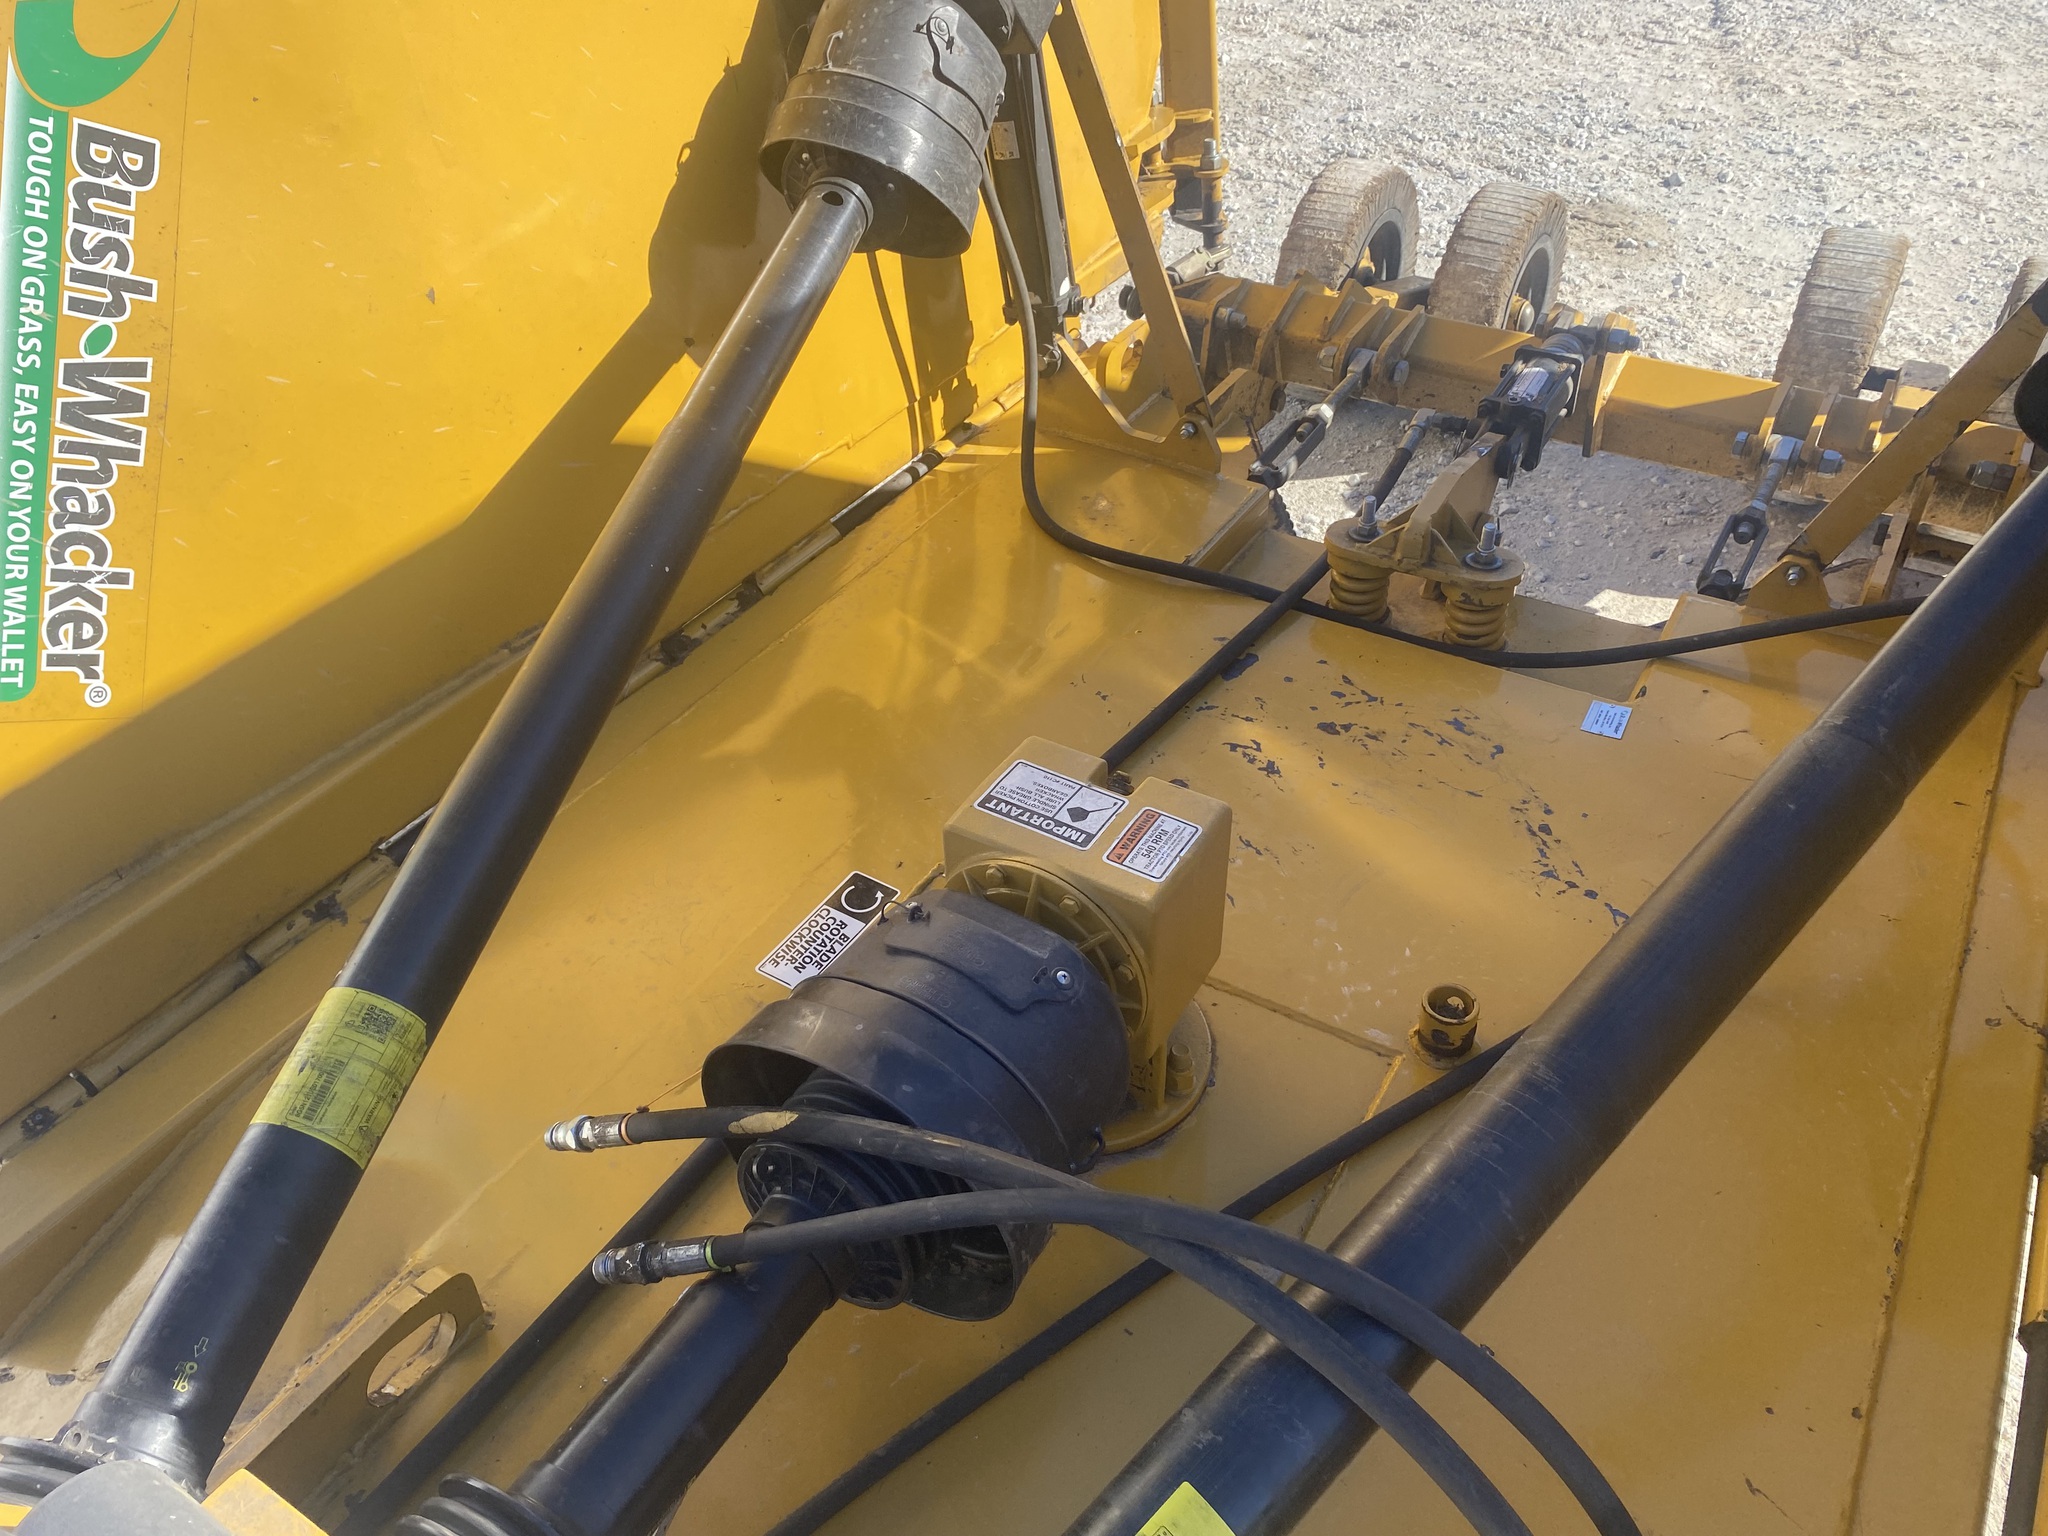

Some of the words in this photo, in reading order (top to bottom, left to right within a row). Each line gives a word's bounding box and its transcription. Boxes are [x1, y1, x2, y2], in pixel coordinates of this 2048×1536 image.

[25, 116, 54, 219] TOUGH
[22, 226, 48, 270] ON
[12, 276, 46, 375] GRASS,
[12, 384, 39, 454] EASY
[9, 460, 34, 499] ON
[5, 506, 32, 580] YOUR
[0, 585, 27, 688] WALLET
[994, 789, 1016, 800] PICKER
[1007, 788, 1032, 799] GREASE
[1015, 797, 1040, 808] COTTON
[1031, 797, 1057, 809] SPINDLE
[1034, 787, 1065, 801] WHACKER
[1044, 796, 1061, 804] LUBE
[982, 797, 1088, 842] IMPORTANT
[1119, 812, 1155, 850] WARNING
[1127, 846, 1144, 863] OPERATE
[1147, 823, 1162, 838] MACHINE
[1140, 844, 1157, 858] 540
[1150, 828, 1170, 845] RPM
[1143, 852, 1160, 869] TRACTOR
[1156, 844, 1166, 852] PTO
[1162, 833, 1174, 845] SPEED
[767, 907, 832, 967] CLOCKWISE
[782, 915, 838, 968] COUNTER-
[792, 919, 848, 973] ROTATION
[811, 932, 850, 970] BLADE
